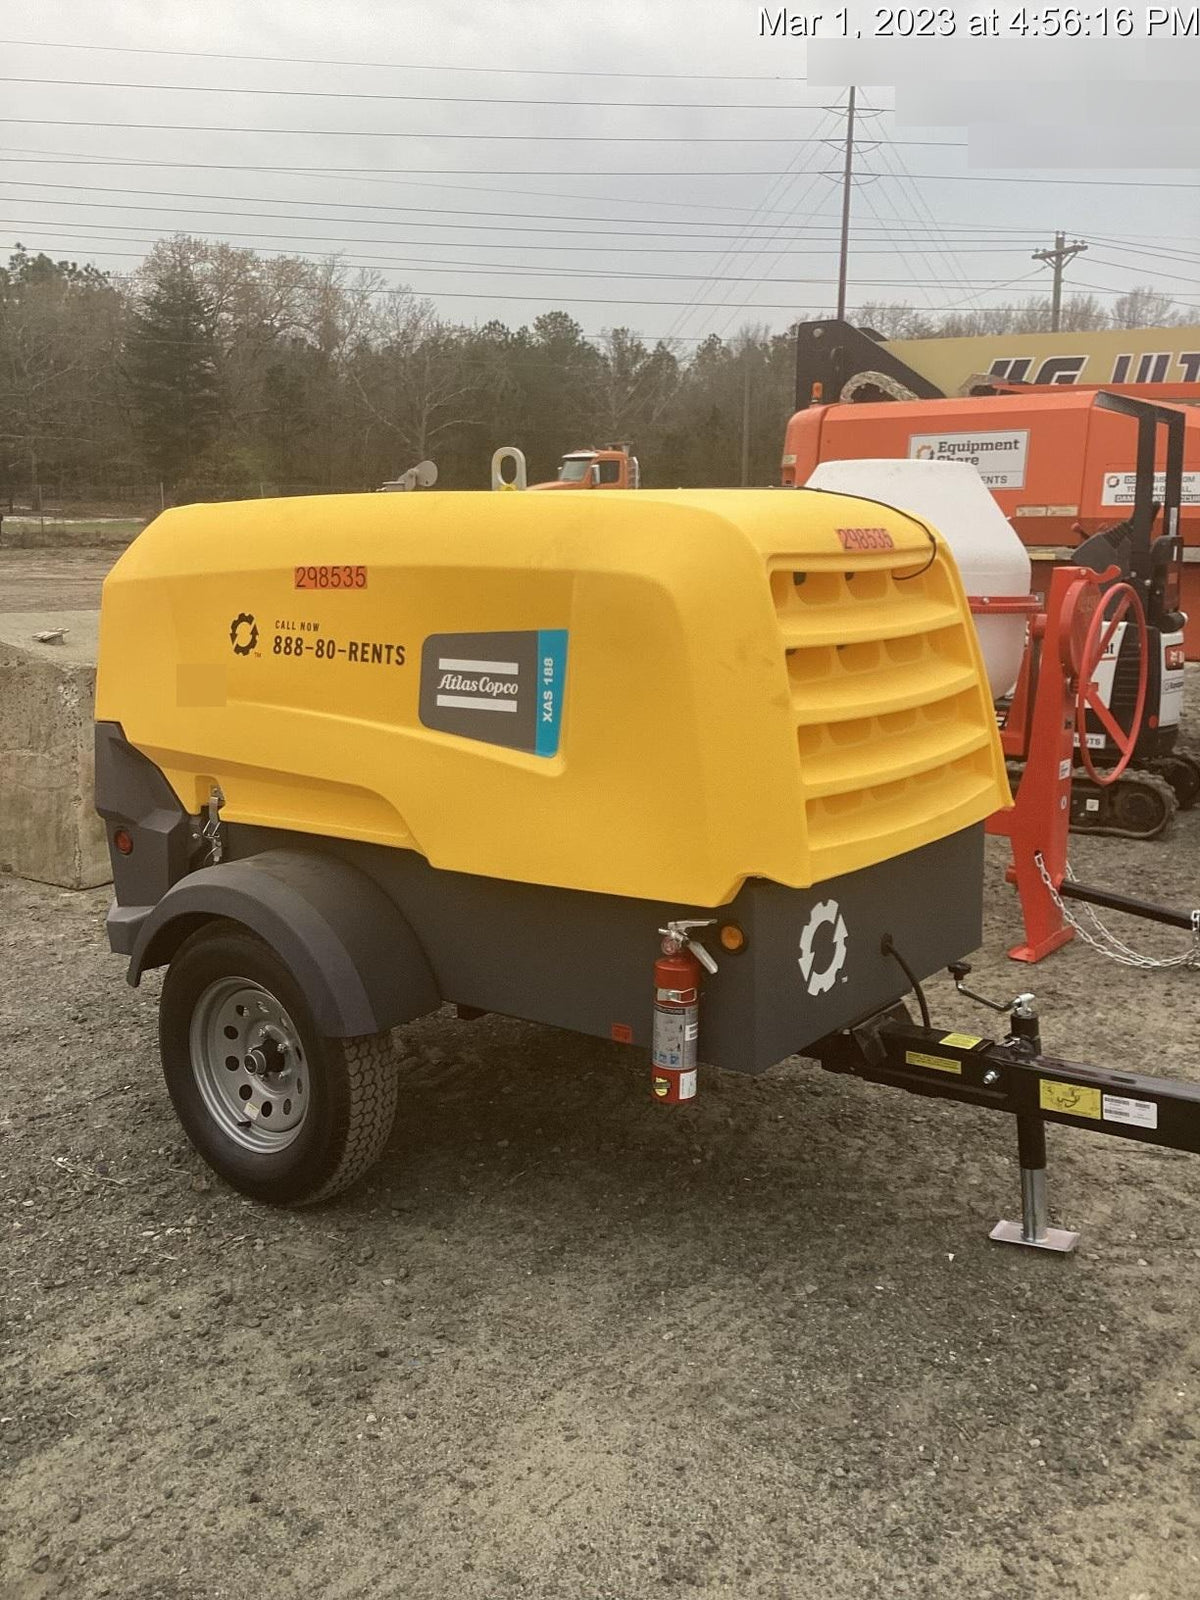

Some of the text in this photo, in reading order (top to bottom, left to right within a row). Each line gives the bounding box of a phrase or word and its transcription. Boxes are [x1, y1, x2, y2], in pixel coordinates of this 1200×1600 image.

[937, 439, 1020, 455] Equipment
[837, 527, 894, 550] 298535
[295, 565, 366, 588] 298535
[275, 619, 320, 632] CALL NOW
[272, 635, 406, 666] 888-80-RENTS
[542, 657, 555, 723] XAS 188
